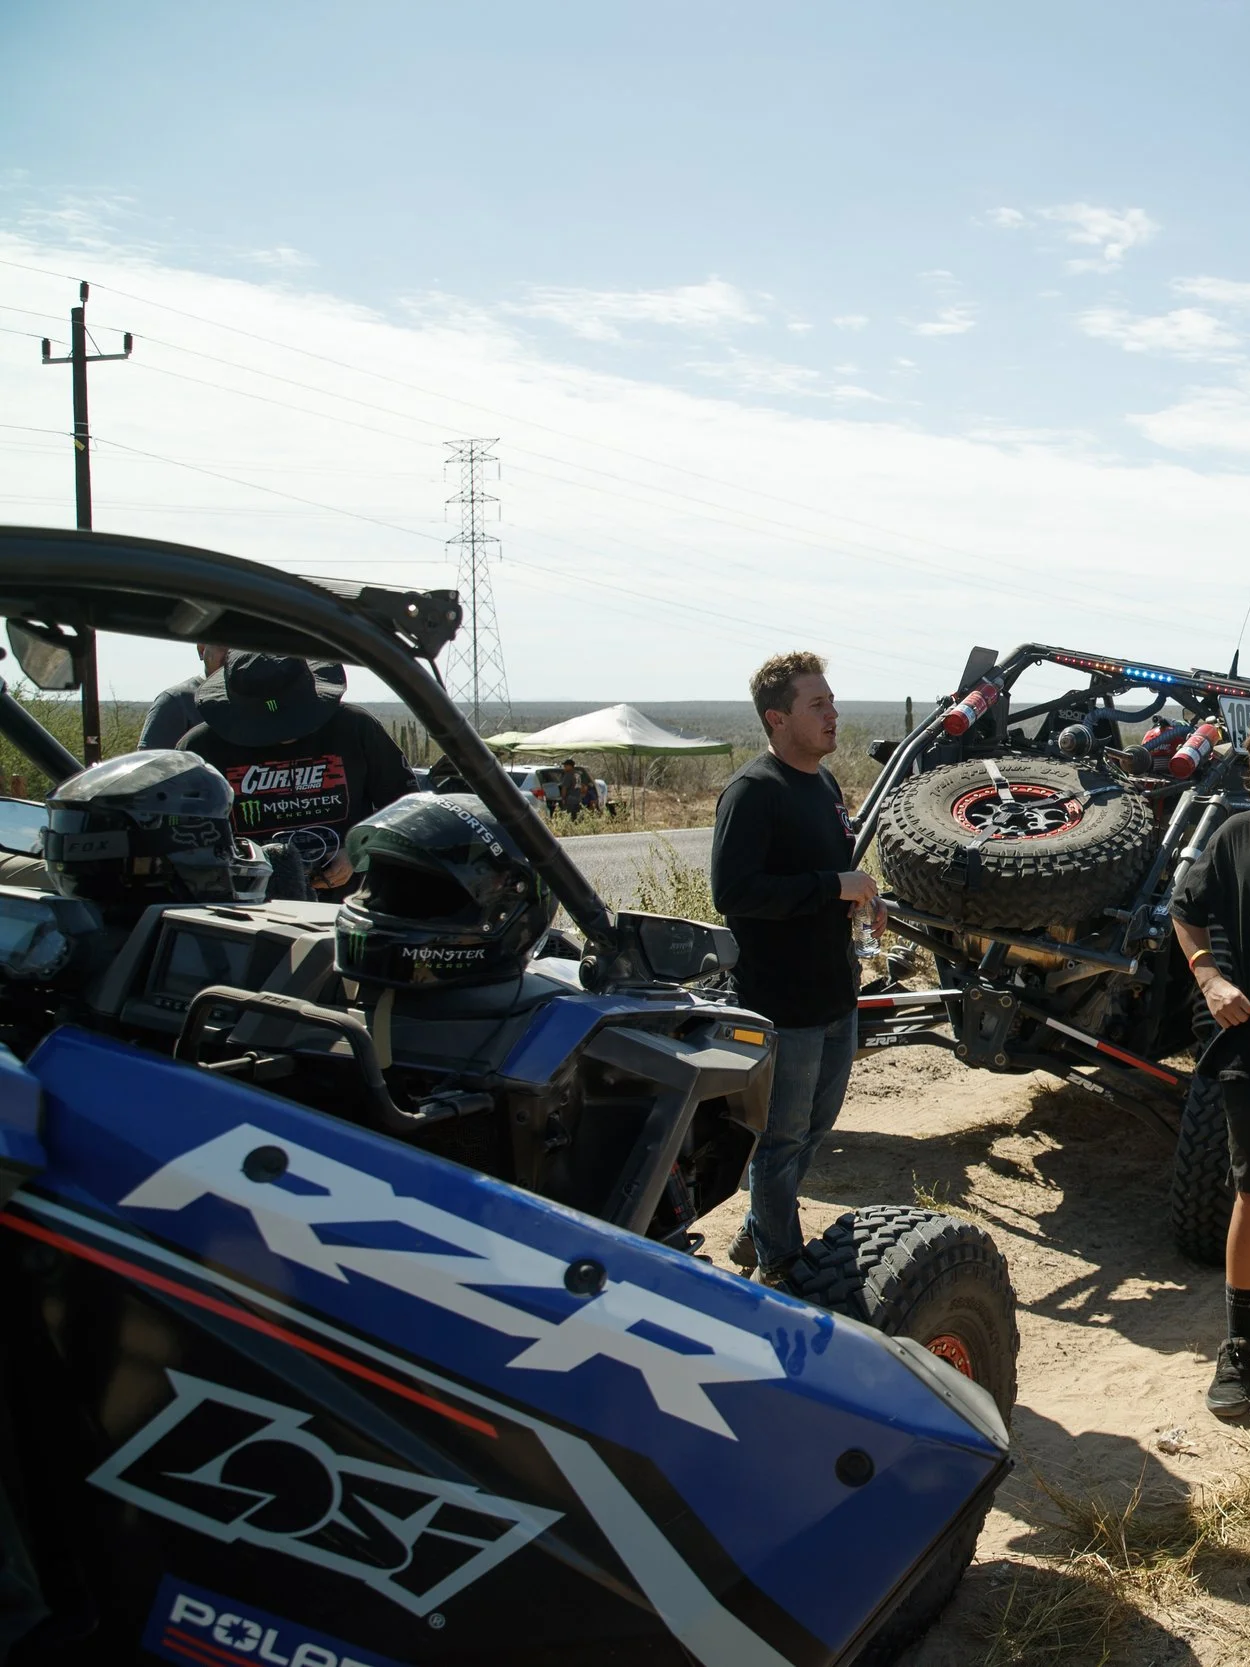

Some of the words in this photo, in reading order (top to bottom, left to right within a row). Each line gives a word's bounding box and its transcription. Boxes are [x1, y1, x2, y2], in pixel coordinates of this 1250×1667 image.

[295, 782, 322, 791] RACING
[263, 794, 342, 814] MONSTER
[276, 807, 331, 820] ENERGY
[68, 840, 109, 852] FOX
[402, 947, 486, 962] MONSTER
[865, 1036, 897, 1047] ZRP
[1066, 1072, 1104, 1095] ZRP
[118, 1123, 787, 1441] RZR
[169, 1594, 375, 1667] POLA
